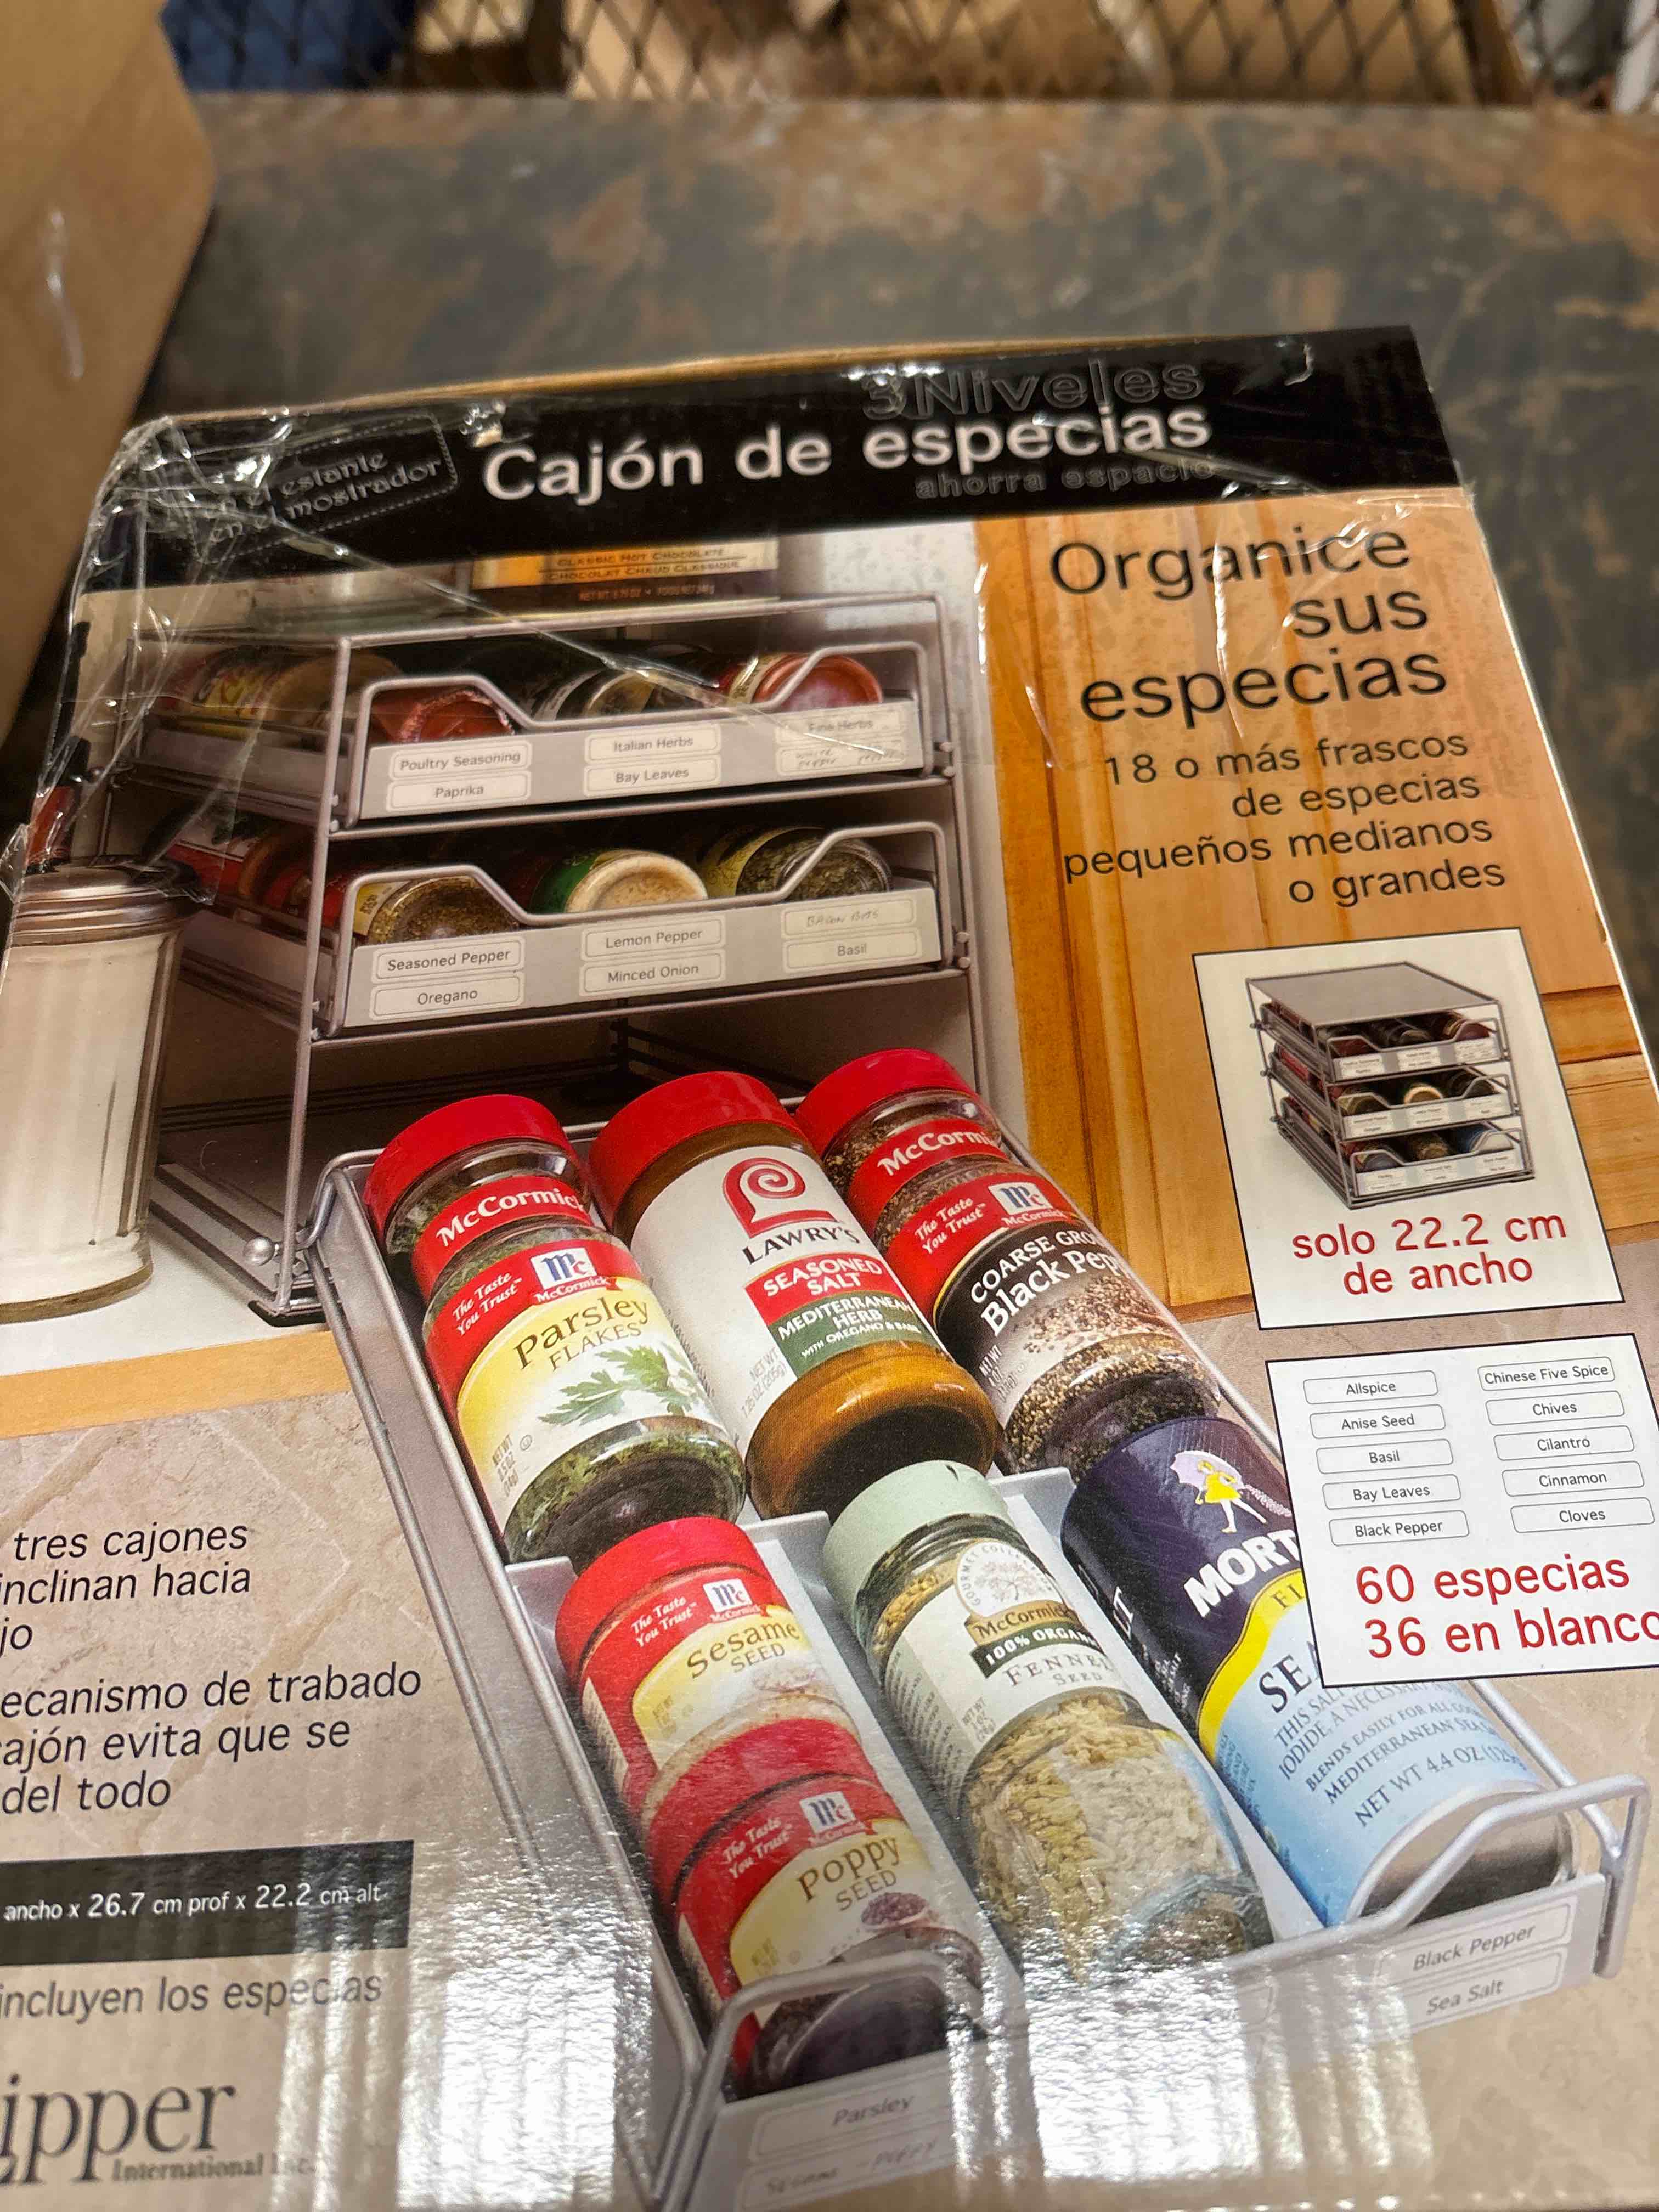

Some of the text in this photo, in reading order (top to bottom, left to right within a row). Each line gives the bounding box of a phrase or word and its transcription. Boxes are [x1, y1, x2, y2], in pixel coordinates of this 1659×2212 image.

[483, 405, 1212, 506] Cajón de especias
[284, 461, 440, 518] mostrador
[916, 471, 1046, 499] ahorra
[1049, 524, 1410, 601] Organice
[1291, 588, 1428, 639] sus
[1080, 647, 1448, 729] especias
[400, 751, 521, 772] Poultry Seasoning
[613, 735, 695, 753] Italian Herbs
[1104, 731, 1469, 786] 18 o más frascos
[435, 783, 484, 799] Paprika
[615, 768, 690, 785] Bay Leaves
[1232, 772, 1481, 819] de especias
[1064, 817, 1493, 885] pequeños medianos
[1289, 859, 1505, 908] o grandes
[605, 928, 703, 950] Lemon Pepper
[837, 943, 867, 957] Basil
[387, 949, 512, 972] Seasoned Pepper
[607, 963, 699, 984] Minced Onion
[416, 988, 478, 1006] Oregano
[914, 1197, 974, 1242] The Taste
[1291, 1213, 1567, 1259] solo 22.2 cm
[741, 1226, 860, 1266] LAWRY'S
[922, 1234, 948, 1255] You
[763, 1258, 882, 1297] SEASONED
[807, 1272, 863, 1296] SALT
[970, 1235, 1056, 1305] COARSE
[1344, 1251, 1533, 1295] de ancho
[453, 1271, 512, 1322] The Taste
[534, 1276, 610, 1304] McCormick
[980, 1259, 1070, 1338] Black
[455, 1314, 480, 1337] You
[514, 1296, 650, 1370] Parsley
[832, 1309, 883, 1330] HERB
[548, 1321, 642, 1372] FLAKES
[801, 1339, 825, 1358] WITH
[1346, 1380, 1397, 1396] Allspice
[1483, 1364, 1609, 1386] Chinese Five Spice
[1341, 1413, 1415, 1431] Anise Seed
[1532, 1402, 1578, 1416] Chives
[1368, 1449, 1400, 1464] Basil
[1537, 1436, 1591, 1451] Cilantro
[1352, 1483, 1431, 1503] Bay Leaves
[1538, 1471, 1608, 1487] Cinnamon
[1354, 1520, 1443, 1538] Black Pepper
[1559, 1508, 1606, 1523] Cloves
[14, 1521, 249, 1562] tres cajones
[152, 1561, 252, 1597] hacia
[1356, 1553, 1630, 1605] 60 especias
[630, 1594, 687, 1635] The Taste
[1364, 1607, 1659, 1659] 36 en blanco
[635, 1626, 661, 1648] You
[686, 1621, 802, 1680] Sesame
[985, 1634, 1031, 1666] 100%
[731, 1641, 786, 1673] SEED
[204, 1670, 250, 1706] de
[267, 1661, 422, 1703] trabado
[1052, 1671, 1103, 1688] SEED
[1274, 1707, 1311, 1748] THIS
[1329, 1712, 1345, 1729] A
[102, 1719, 351, 1763] evita que se
[1305, 1741, 1351, 1792] BLENDS
[1354, 1713, 1395, 1747] EASILY
[1398, 1702, 1427, 1722] FOR
[1427, 1701, 1448, 1714] ALL
[1323, 1718, 1453, 1805] MEDITERRANEAN
[1, 1769, 171, 1814] del todo
[1354, 1784, 1393, 1828] NET
[1390, 1763, 1424, 1793] WT
[1426, 1751, 1454, 1773] 4.4
[1452, 1745, 1486, 1764] OZ
[723, 1816, 782, 1865] The Taste
[728, 1854, 755, 1880] You
[795, 1834, 901, 1902] Poppy
[4, 1898, 63, 1921] ancho
[70, 1903, 81, 1919] x
[87, 1891, 145, 1918] 26.7
[153, 1897, 183, 1914] cm
[188, 1889, 230, 1917] prof
[235, 1897, 247, 1911] x
[254, 1882, 312, 1910] 22.2
[835, 1869, 898, 1912] SEED
[1413, 1922, 1537, 1973] Black Pepper
[0, 1974, 382, 2025] incluyen los especias
[1426, 1979, 1504, 2016] Sea Salt
[832, 2095, 915, 2128] Parsley
[110, 2152, 264, 2182] International
